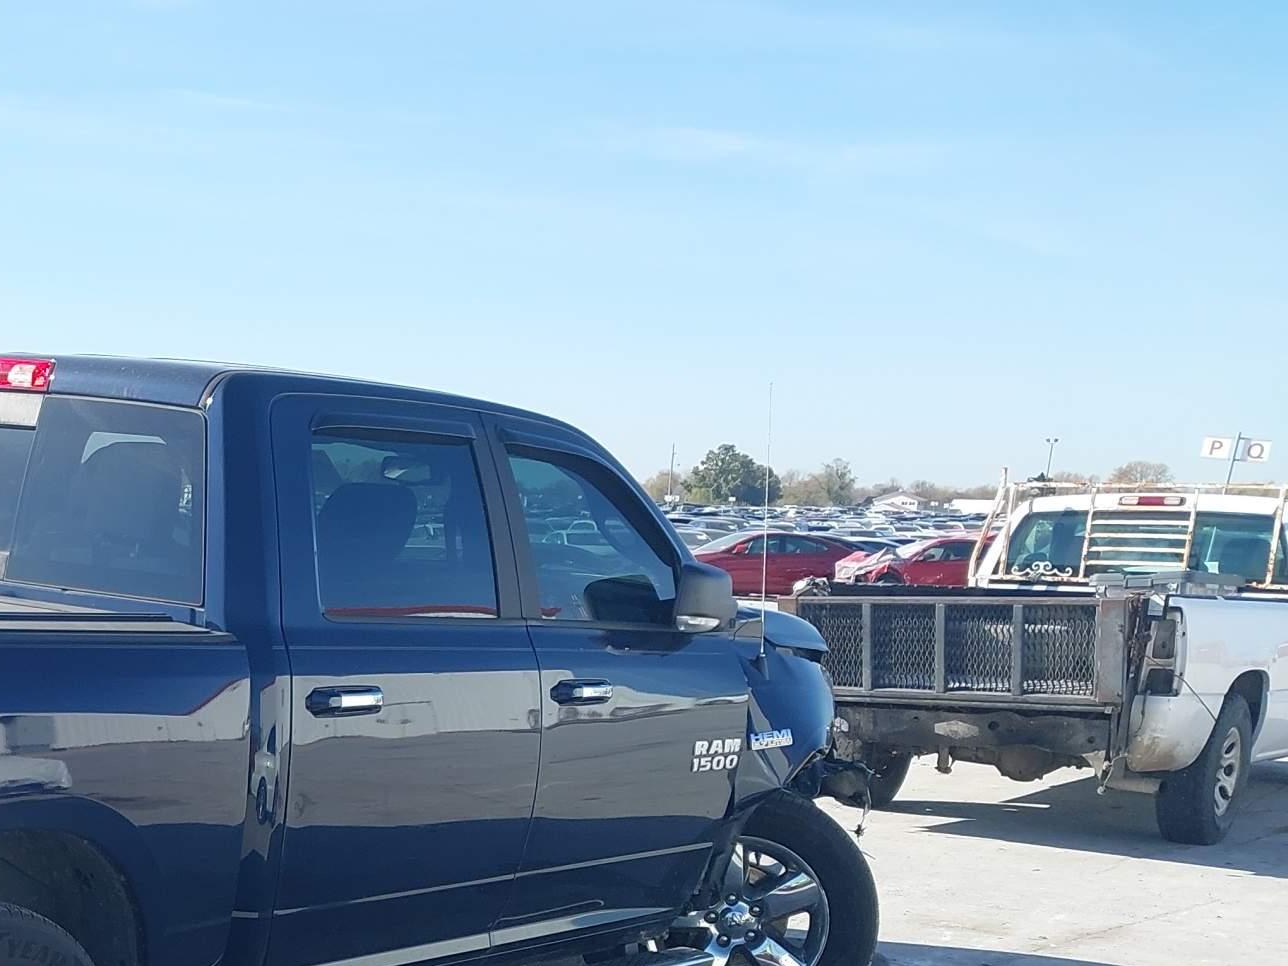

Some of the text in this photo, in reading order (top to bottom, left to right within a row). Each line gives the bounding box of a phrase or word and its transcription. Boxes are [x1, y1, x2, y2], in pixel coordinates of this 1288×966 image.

[1209, 440, 1224, 456] P
[1247, 443, 1265, 460] Q
[750, 728, 792, 744] HEMI
[694, 738, 742, 756] RAM
[691, 754, 739, 773] 1500
